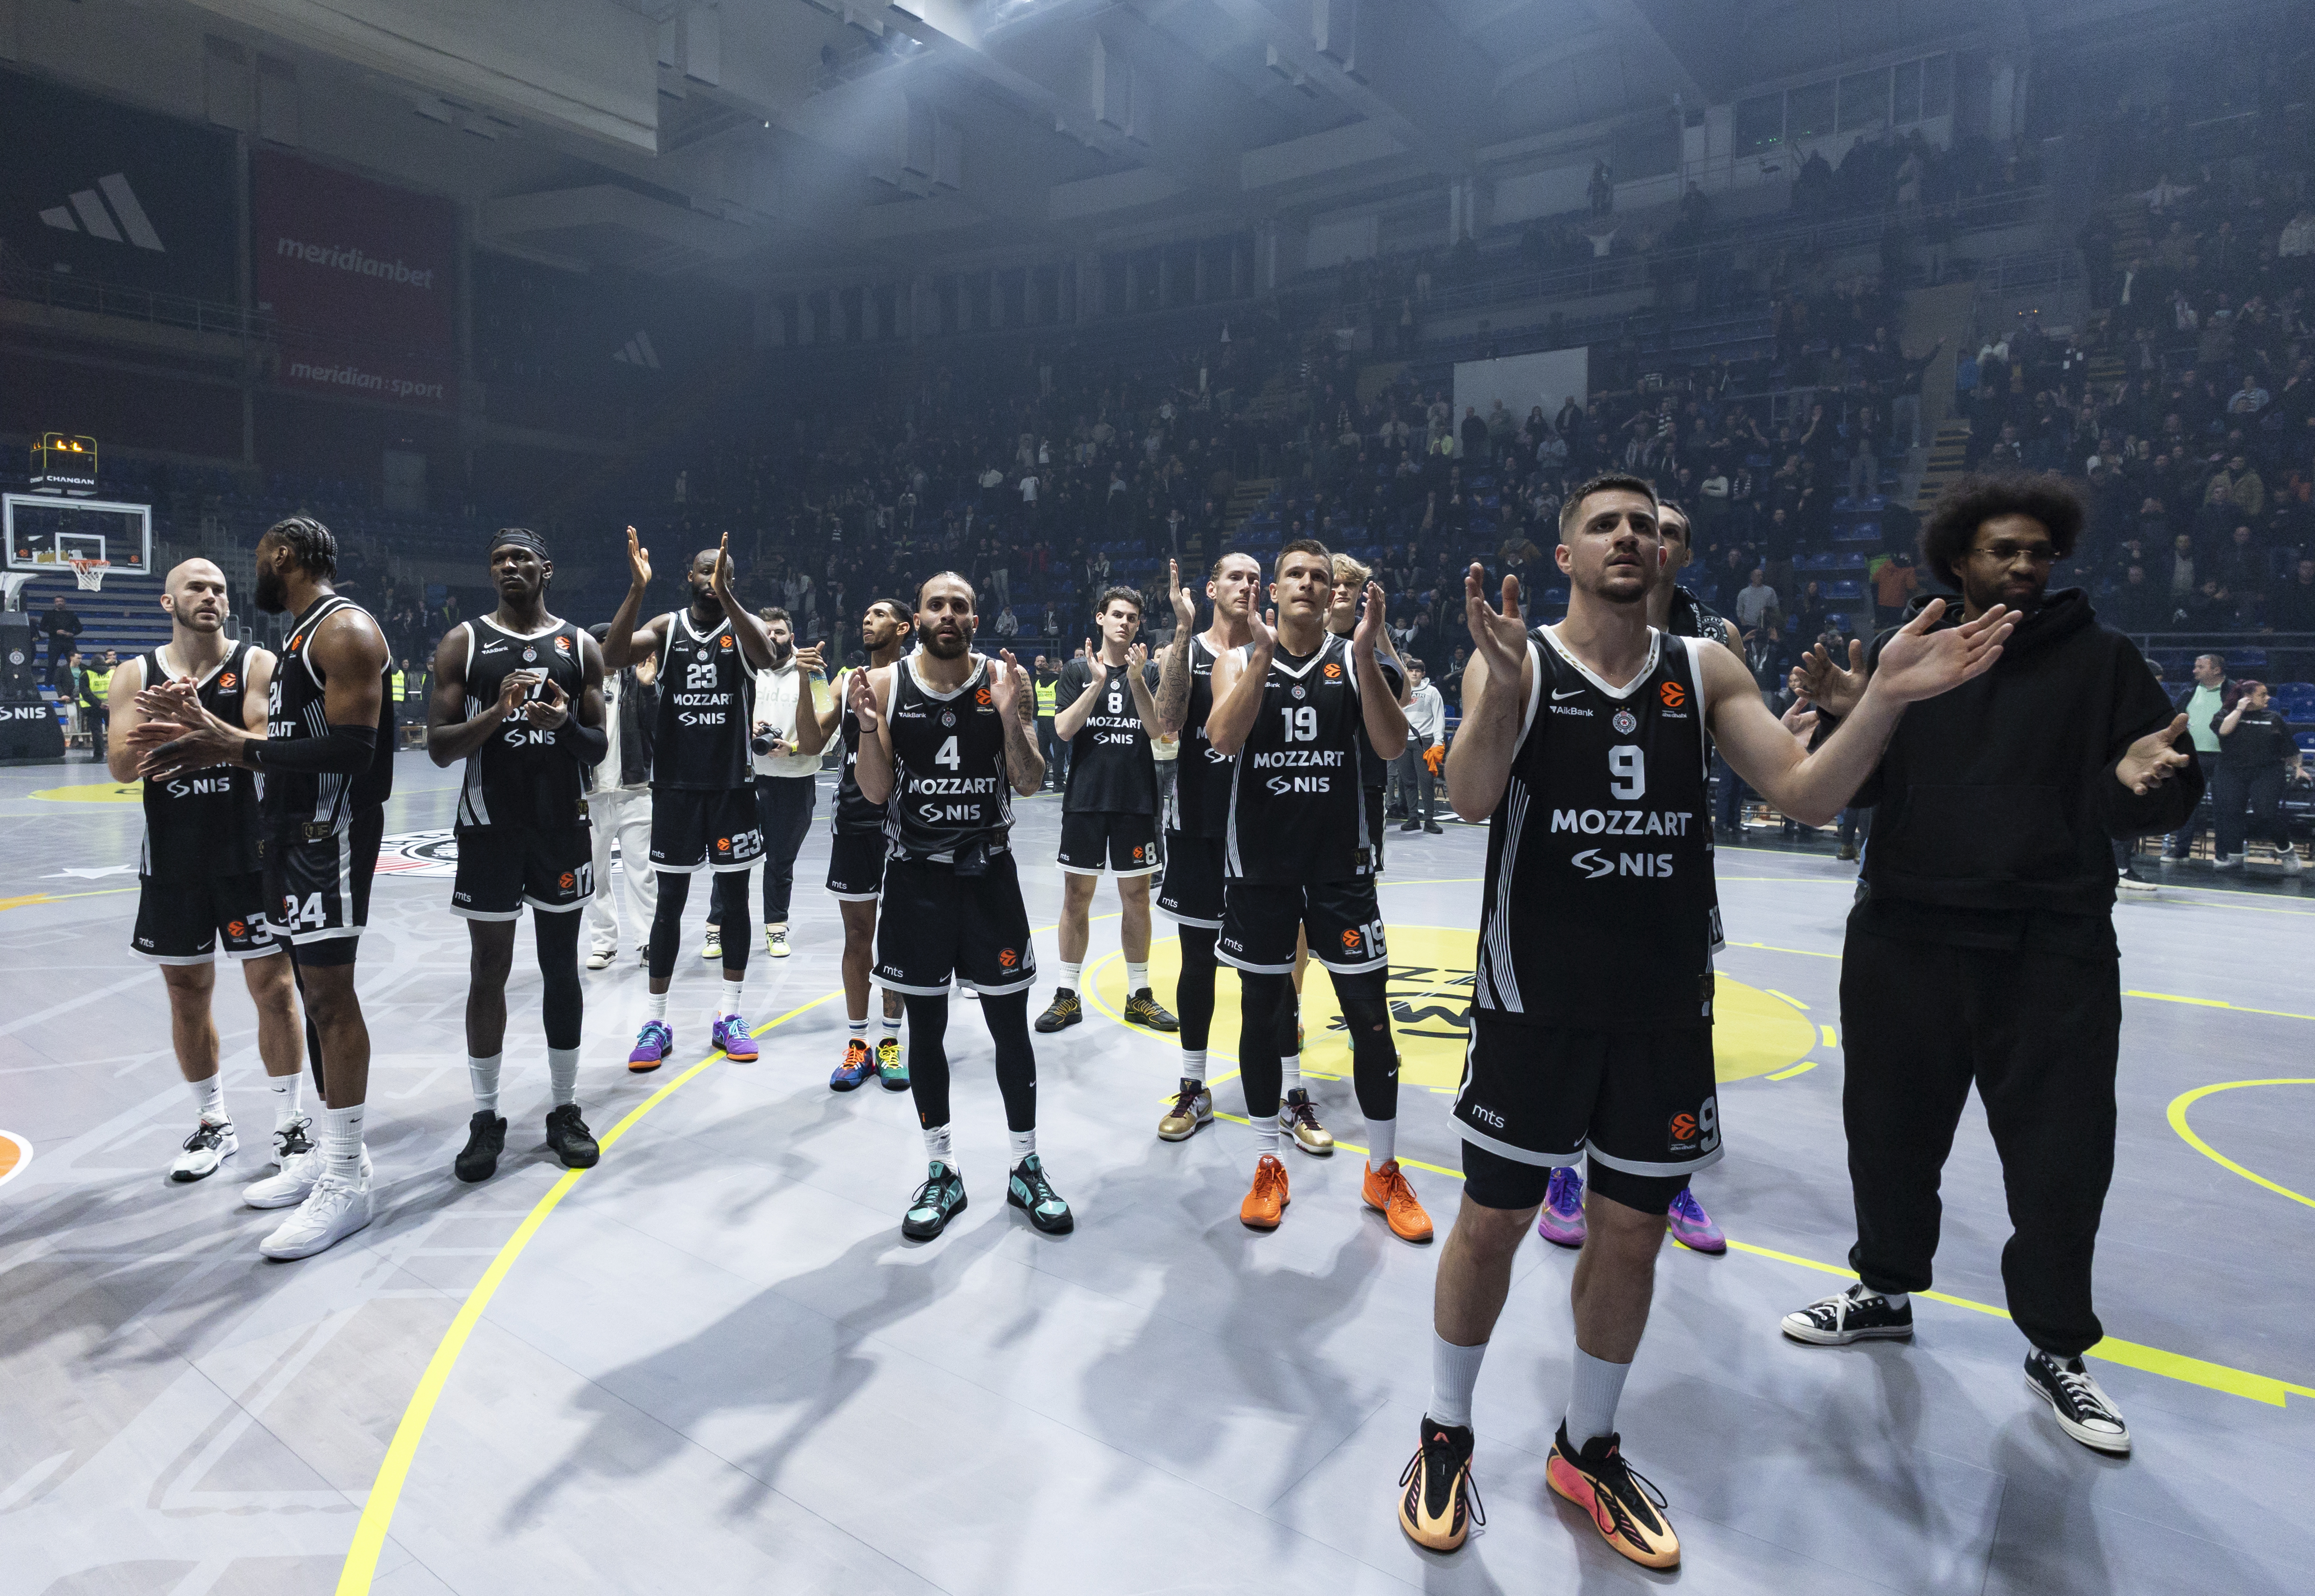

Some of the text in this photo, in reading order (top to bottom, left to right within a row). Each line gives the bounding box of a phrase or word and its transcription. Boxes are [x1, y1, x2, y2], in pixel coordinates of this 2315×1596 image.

[277, 237, 434, 289] meridianbet
[290, 362, 443, 399] meridian:sport
[47, 475, 94, 485] CHANGAN
[687, 663, 717, 689] 23
[269, 680, 282, 716] 24
[673, 693, 734, 706] MOZZART
[1108, 693, 1122, 714] 8
[14, 707, 47, 719] NIS
[699, 713, 726, 724] NIS
[1557, 706, 1594, 717] AikBank
[1086, 717, 1142, 729] MOZZART
[1281, 706, 1317, 742] 19
[529, 729, 555, 745] NIS
[1111, 734, 1133, 744] NIS
[935, 736, 960, 770] 4
[1254, 751, 1344, 768] MOZZART
[1609, 745, 1645, 800] 9
[193, 777, 230, 794] NIS
[909, 778, 996, 794] MOZZART
[1294, 777, 1330, 792] NIS
[946, 805, 980, 820] NIS
[1551, 809, 1693, 836] MOZZART
[732, 829, 761, 859] 23
[651, 849, 665, 859] mts
[1145, 842, 1157, 865] 8
[1620, 853, 1673, 877] NIS
[574, 861, 592, 897] 17
[832, 880, 847, 889] mts
[455, 891, 471, 903] mts
[1162, 896, 1178, 908] mts
[286, 892, 327, 930] 24
[246, 912, 273, 945] 3
[139, 937, 154, 948] mts
[1224, 937, 1243, 952] mts
[1359, 919, 1386, 958] 19
[1022, 938, 1035, 971] 4
[883, 965, 903, 978] mts
[1472, 1104, 1505, 1128] mts
[1699, 1096, 1719, 1153] 9
